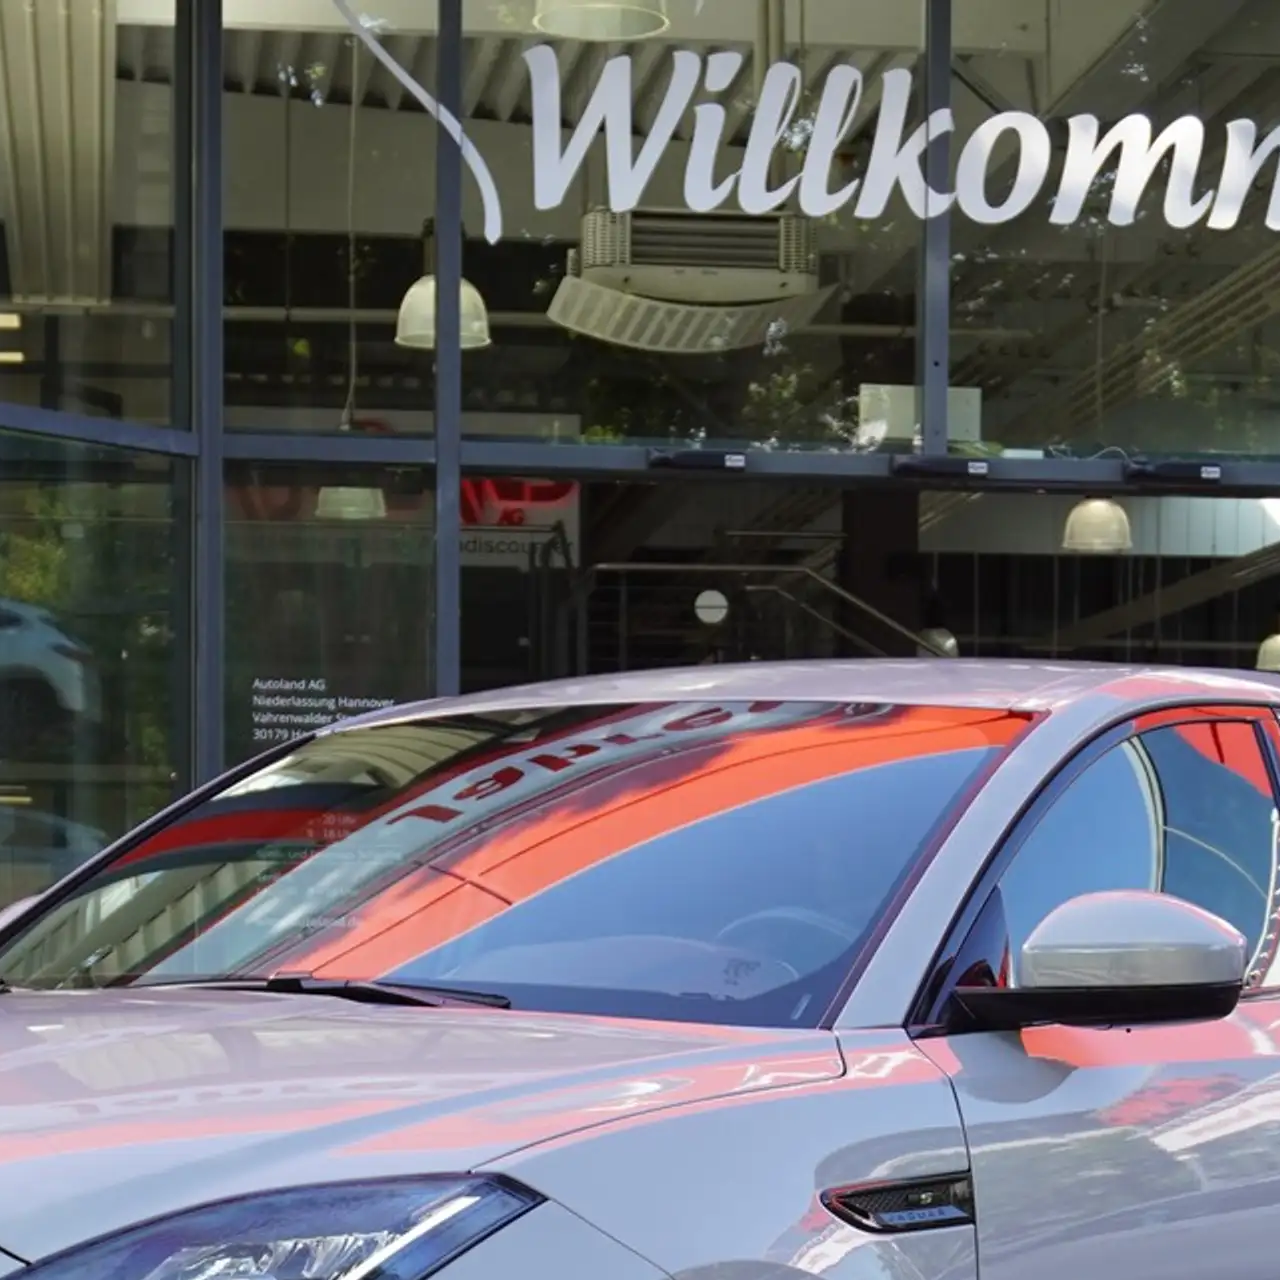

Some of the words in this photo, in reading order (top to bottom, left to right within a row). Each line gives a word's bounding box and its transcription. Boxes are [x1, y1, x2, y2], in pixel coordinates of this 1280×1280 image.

[252, 678, 305, 690] Autoland
[308, 678, 326, 691] AG
[252, 695, 336, 710] Niederlassung
[338, 696, 394, 708] Hannover
[252, 712, 332, 724] Vahrenwalder
[252, 728, 289, 740] 30179
